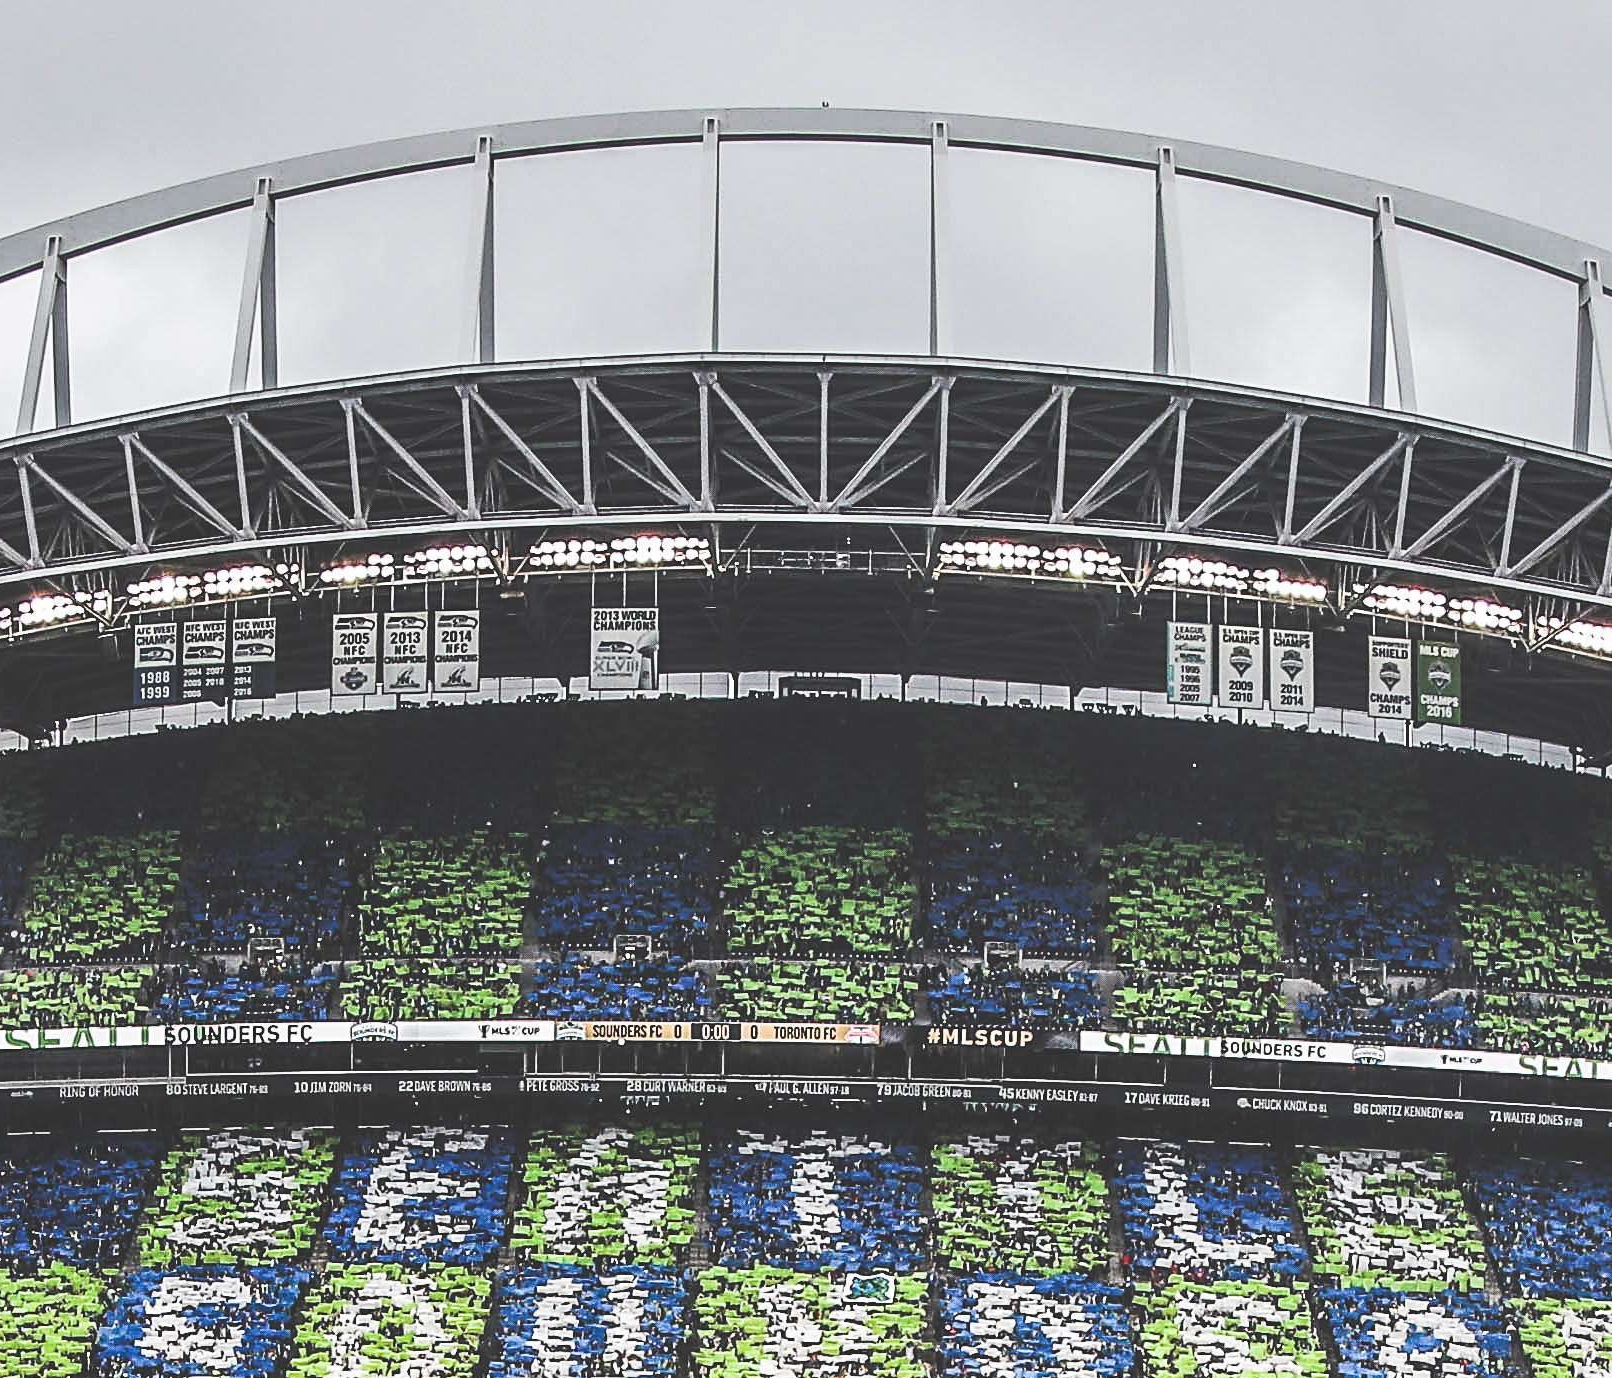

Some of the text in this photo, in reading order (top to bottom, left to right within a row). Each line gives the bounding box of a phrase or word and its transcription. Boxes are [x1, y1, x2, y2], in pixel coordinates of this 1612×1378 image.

[593, 610, 656, 620] 2013 WORLD
[593, 621, 656, 631] CHAMPIONS
[137, 634, 176, 646] CHAMPS
[185, 632, 225, 643] CHAMPS
[234, 629, 275, 641] CHAMPS
[339, 633, 369, 645] 2005
[390, 632, 421, 644] 2013
[441, 631, 472, 642] 2014
[1222, 634, 1260, 645] CHAMPS
[446, 643, 468, 653] NFC
[1273, 637, 1311, 648] CHAMPS
[344, 645, 366, 655] NFC
[394, 645, 417, 655] NFC
[1372, 647, 1408, 659] SHIELD
[1419, 645, 1459, 658] MLS CUP
[140, 671, 170, 685] 1988
[1229, 680, 1254, 691] 2009
[1280, 684, 1303, 695] 2011
[140, 686, 170, 700] 1999
[1229, 691, 1253, 702] 2010
[1370, 693, 1410, 705] CHAMPS
[1280, 695, 1304, 706] 2014
[1420, 694, 1459, 707] CHAMPS
[1378, 704, 1402, 714] 2014
[1426, 705, 1453, 718] 2016
[165, 1023, 540, 1045] SOUNDERS FC MLS CUP
[592, 1023, 837, 1040] SOUNDERS FC 0 0:00 0 TORONTO FC
[927, 1028, 1034, 1047] #MLSCUP
[1221, 1040, 1327, 1059] SOUNDERS FC
[59, 1084, 139, 1098] RING OF HONOR
[166, 1082, 248, 1095] 80 STEVE LARGENT
[294, 1082, 352, 1093] 10 ZORN
[398, 1081, 471, 1092] 22 DAVE BROWN
[526, 1081, 579, 1092] PETE GROSS
[627, 1081, 706, 1092] 28 CURT WARNER
[803, 1083, 830, 1095] ALLEN
[877, 1084, 951, 1097] 79 JACOB GREEN
[999, 1088, 1078, 1101] 45 KENNY EASLEY
[1125, 1092, 1189, 1106] 17 DAVE KRIEG
[1253, 1098, 1308, 1112] CHUCK KNOX
[1353, 1102, 1443, 1119] 96 CORTEZ KENNEDY
[1490, 1110, 1564, 1127] 71 WALTER JONES
